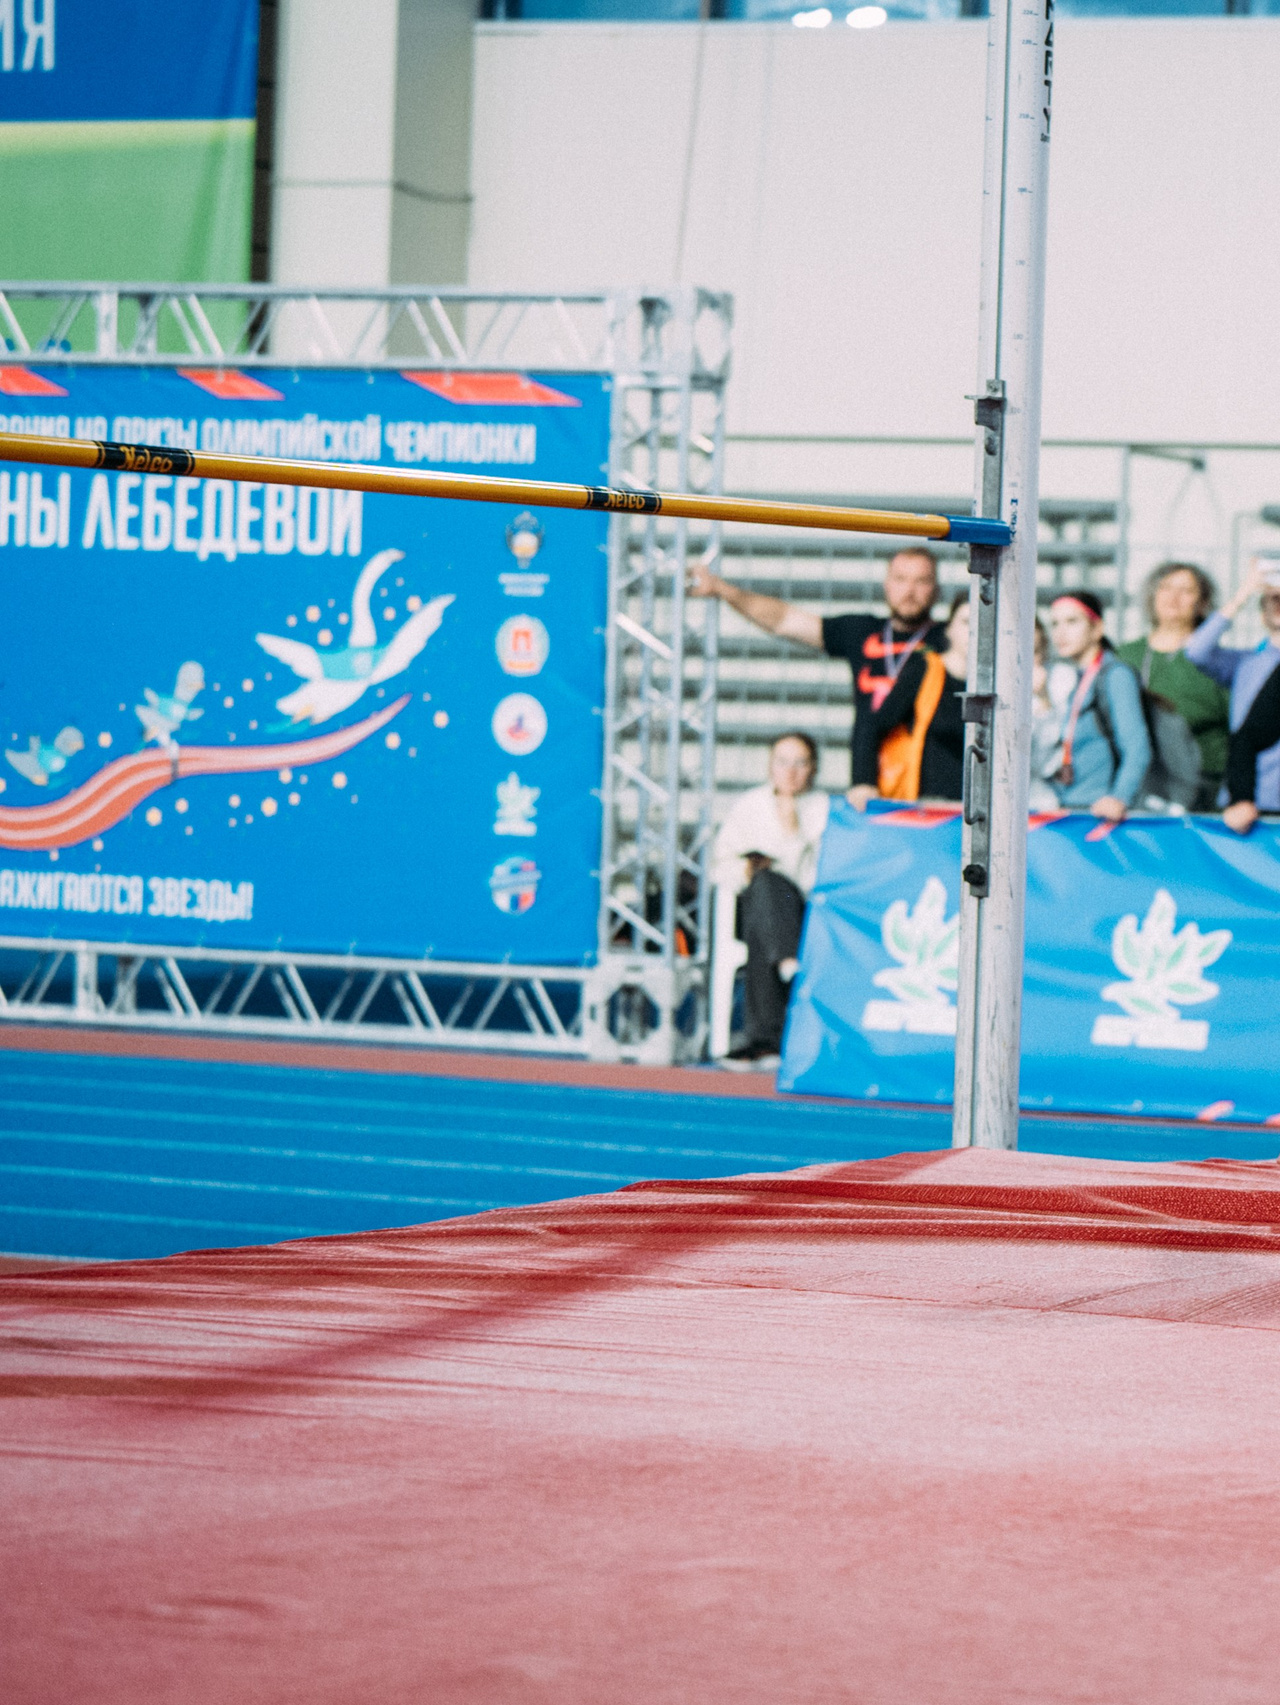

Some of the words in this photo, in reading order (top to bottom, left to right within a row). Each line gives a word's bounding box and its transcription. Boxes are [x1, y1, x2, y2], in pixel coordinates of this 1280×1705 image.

[117, 445, 174, 473] Nelco
[202, 413, 382, 461] ОЛИМПИЙСКОЙ
[385, 421, 537, 465] ЧЕМПИОНКИ
[0, 471, 71, 549] НЫ
